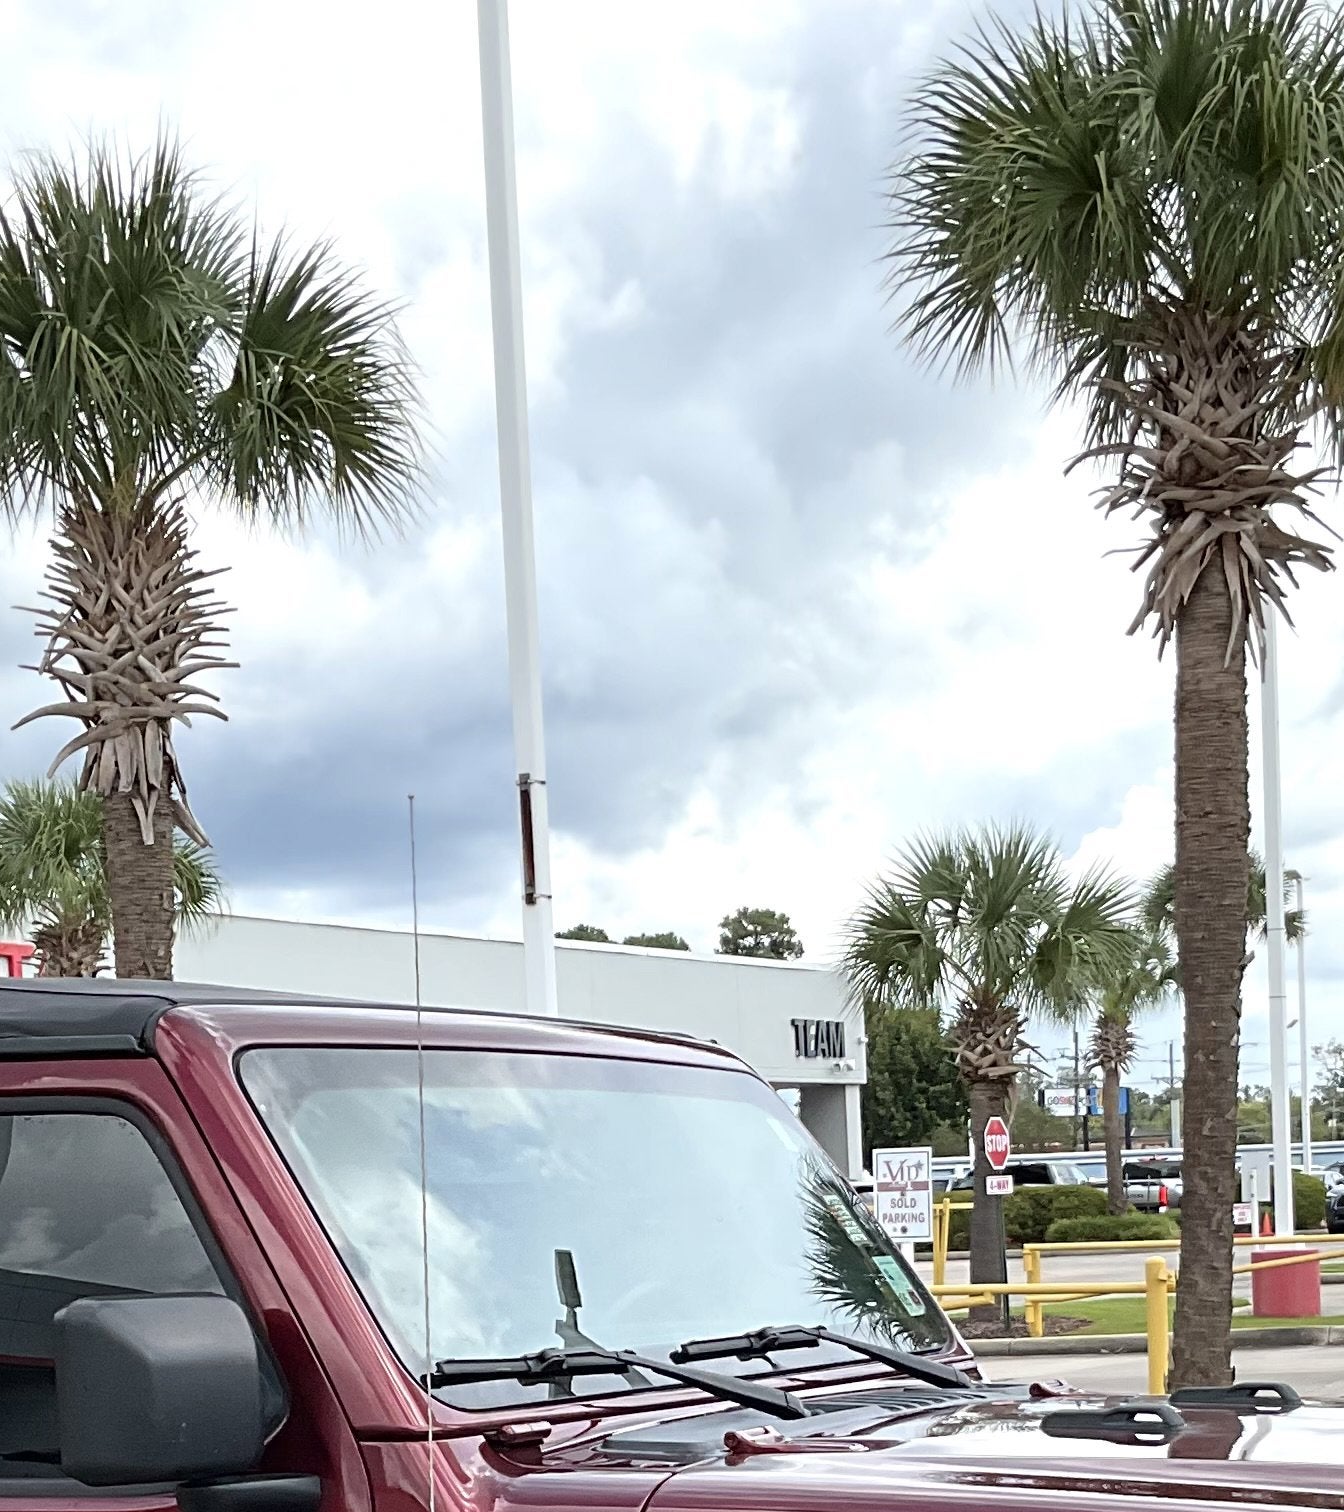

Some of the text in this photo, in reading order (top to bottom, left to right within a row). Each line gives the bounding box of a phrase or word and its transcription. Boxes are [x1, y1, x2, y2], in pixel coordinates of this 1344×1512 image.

[791, 1018, 846, 1058] TEAM
[986, 1134, 1007, 1153] STOP
[989, 1180, 1009, 1190] 4-WAY
[890, 1198, 916, 1209] SOLD
[882, 1212, 925, 1224] PARKING
